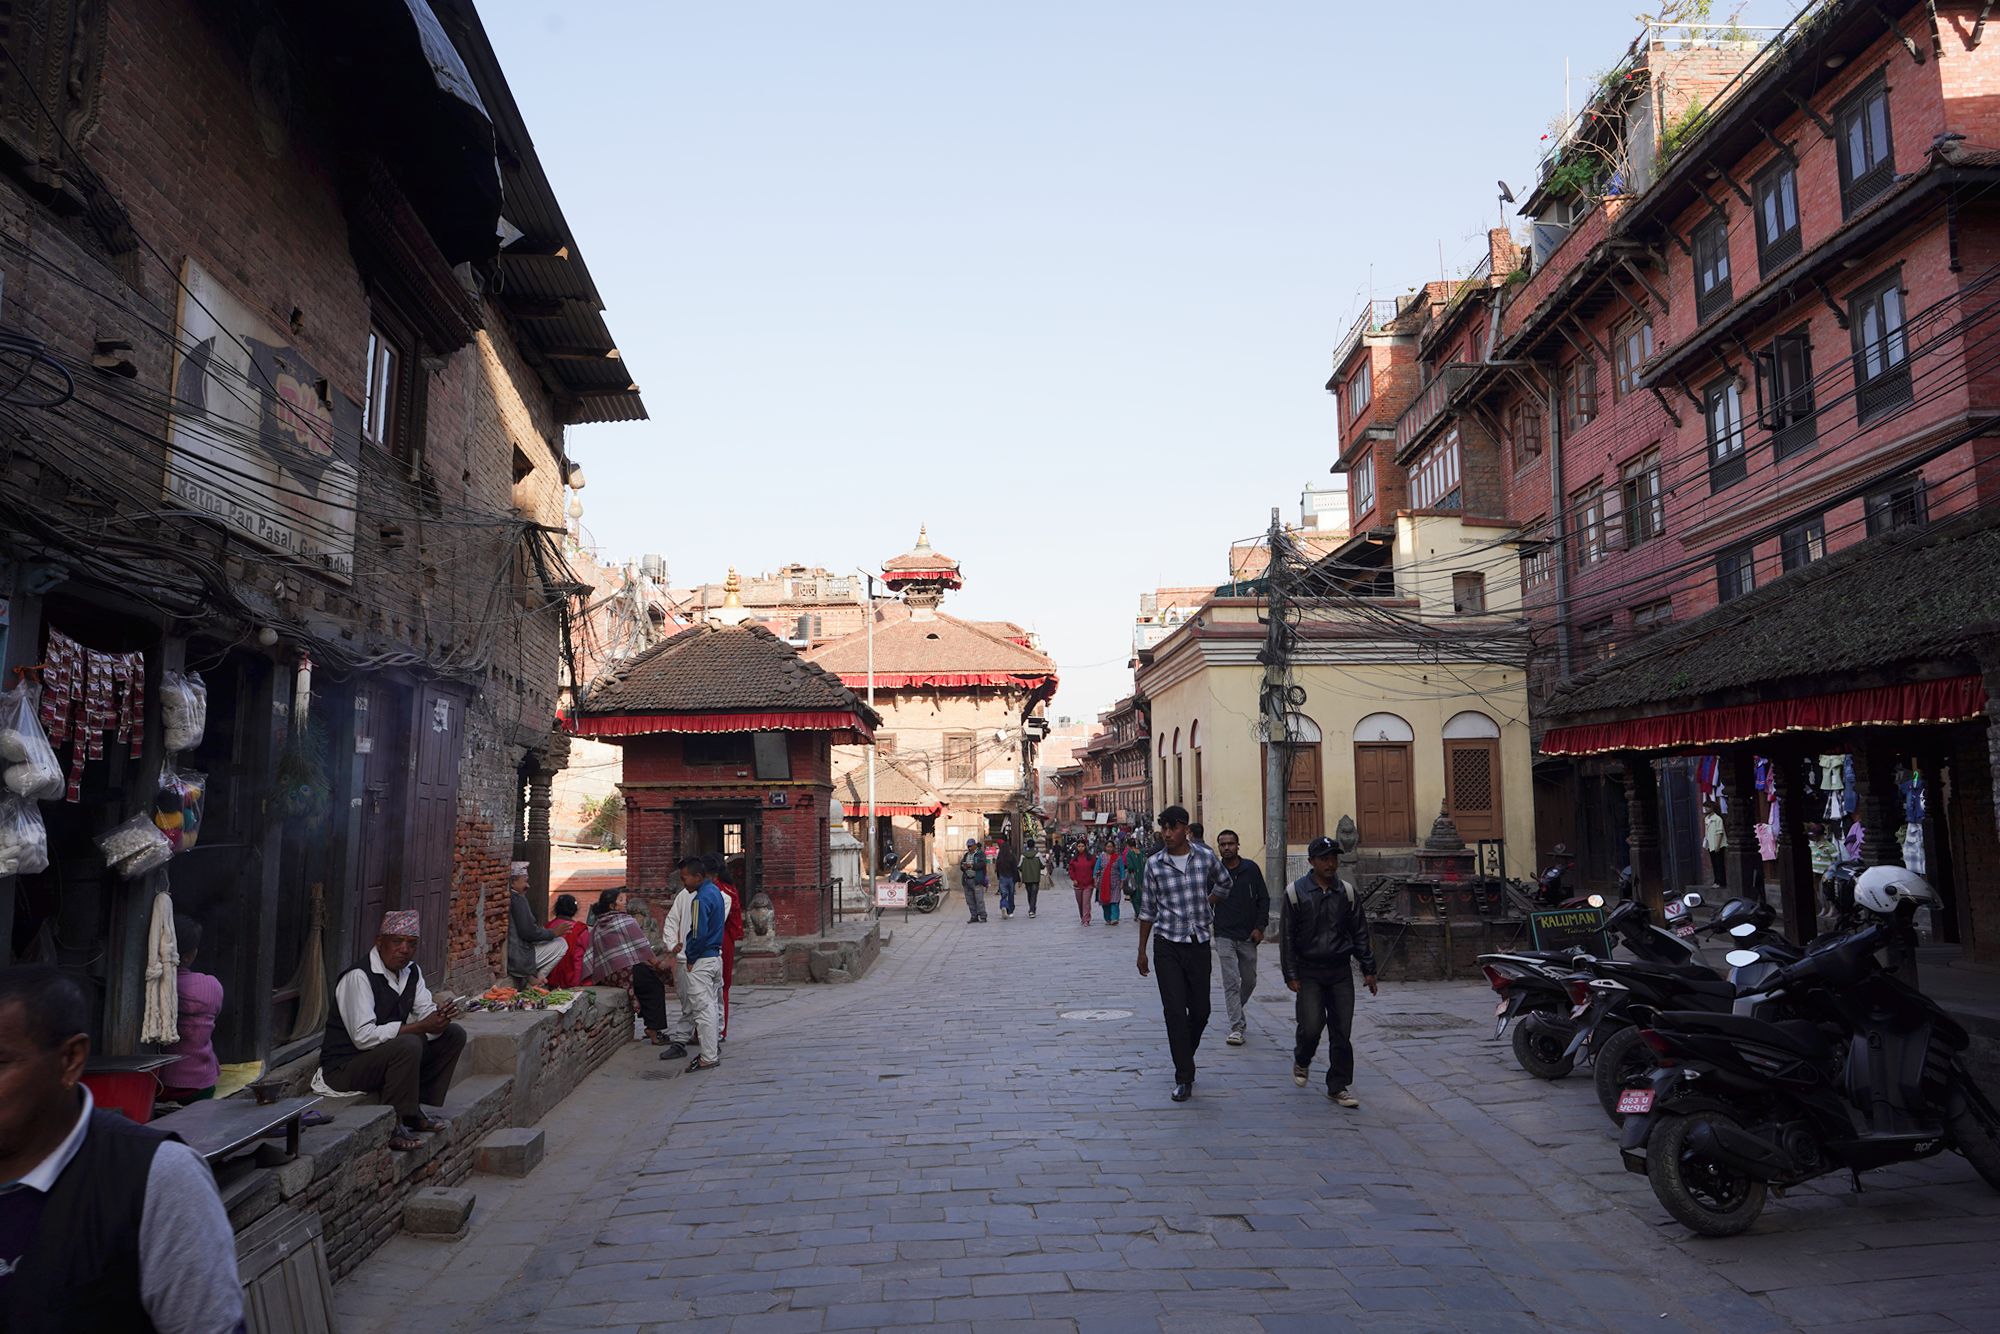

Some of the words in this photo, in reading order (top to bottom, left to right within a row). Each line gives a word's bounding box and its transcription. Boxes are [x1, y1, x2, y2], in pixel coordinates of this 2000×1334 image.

[177, 477, 223, 511] Ratna
[228, 503, 254, 530] Pan
[258, 517, 295, 552] Pasal,
[1540, 913, 1596, 928] KALUMAN
